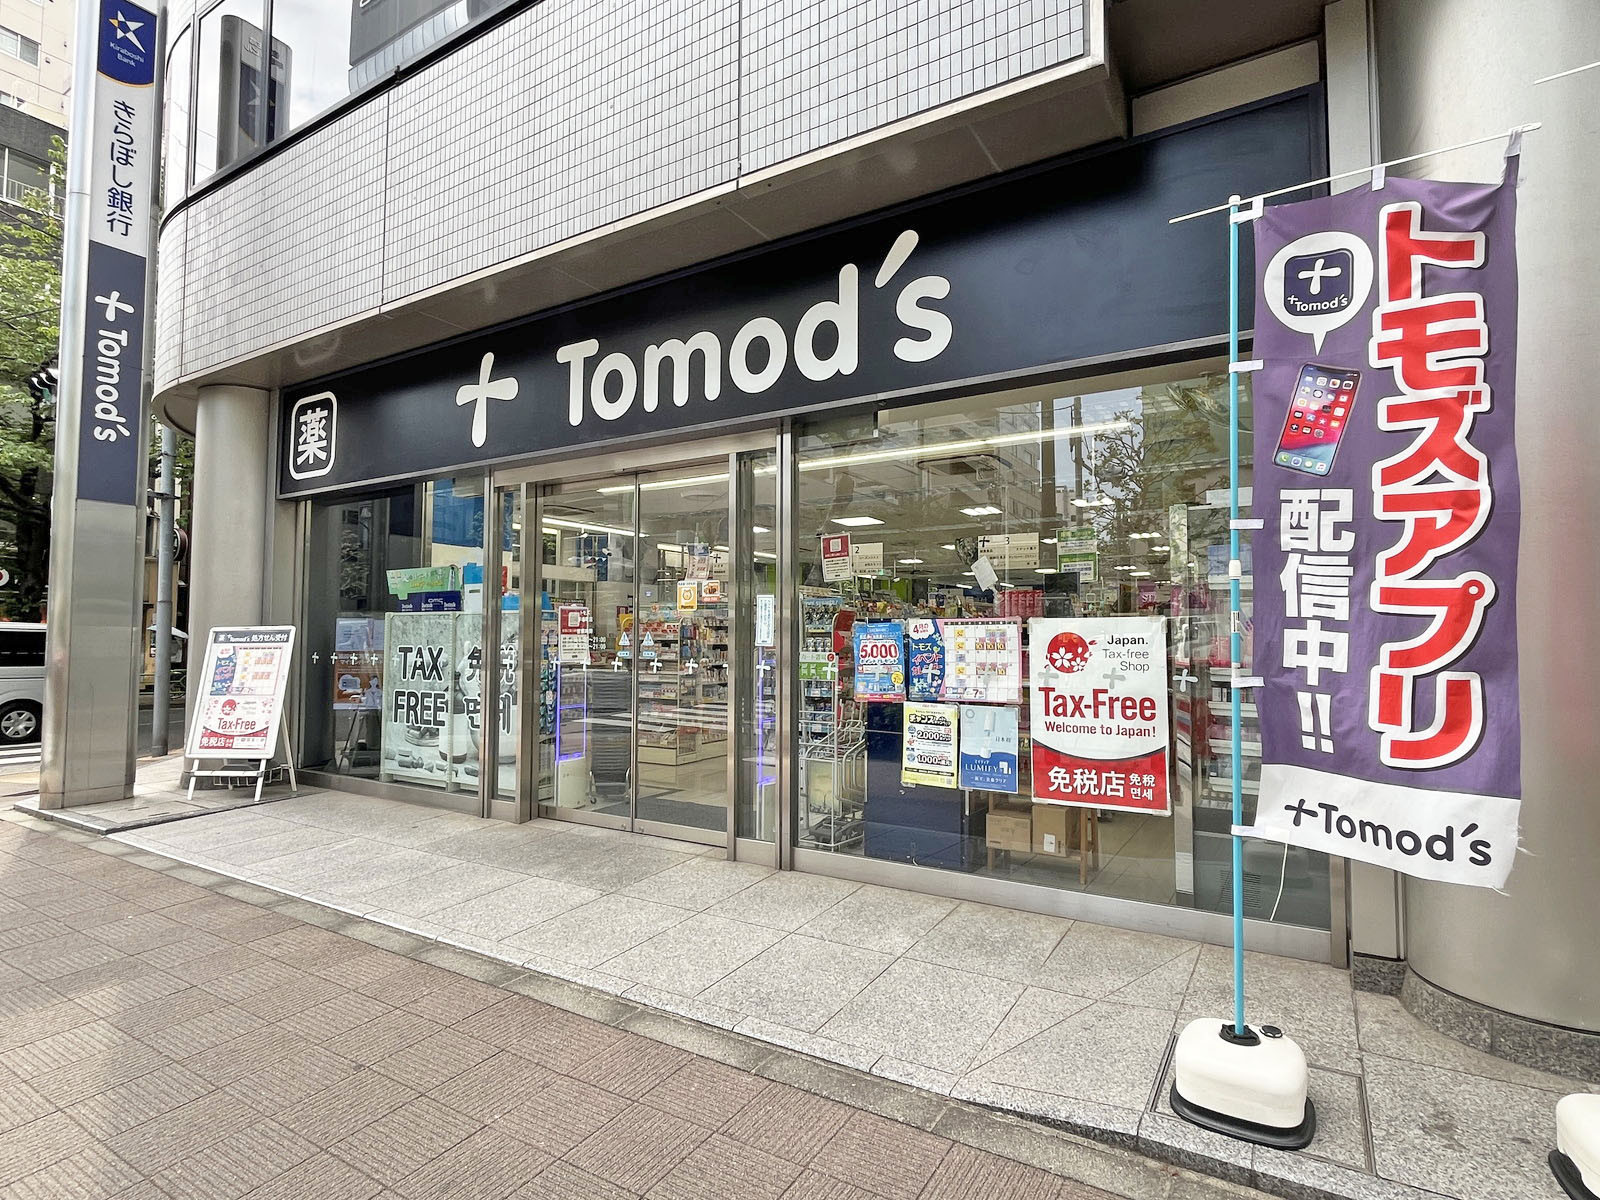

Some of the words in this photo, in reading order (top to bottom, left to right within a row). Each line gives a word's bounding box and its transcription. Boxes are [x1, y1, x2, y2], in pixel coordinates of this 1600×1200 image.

[109, 41, 145, 63] Kiraboshi
[117, 53, 136, 67] Bank
[106, 99, 137, 237] きらぼし銀行
[1294, 293, 1349, 312] Tomod's
[556, 228, 954, 428] Tomod's
[93, 328, 132, 443] Tomod's
[296, 408, 328, 465] 薬
[1370, 202, 1495, 768] トモズアプリ
[854, 545, 860, 554] 2
[1107, 634, 1149, 646] Japan.
[860, 643, 898, 659] 5,000
[1102, 648, 1150, 659] Tax-free
[398, 646, 445, 682] TAX
[1120, 660, 1150, 673] Shop
[393, 690, 446, 727] FREE
[1038, 686, 1157, 722] Tax-Free
[217, 717, 257, 730] Tax-Free
[1044, 721, 1097, 735] Welcome
[1100, 723, 1112, 735] to
[1115, 725, 1156, 739] Japan!
[965, 763, 998, 773] LUMIFY
[1047, 765, 1126, 798] 免税店
[1130, 787, 1154, 801] 면세
[1316, 802, 1493, 867] Tomod's
